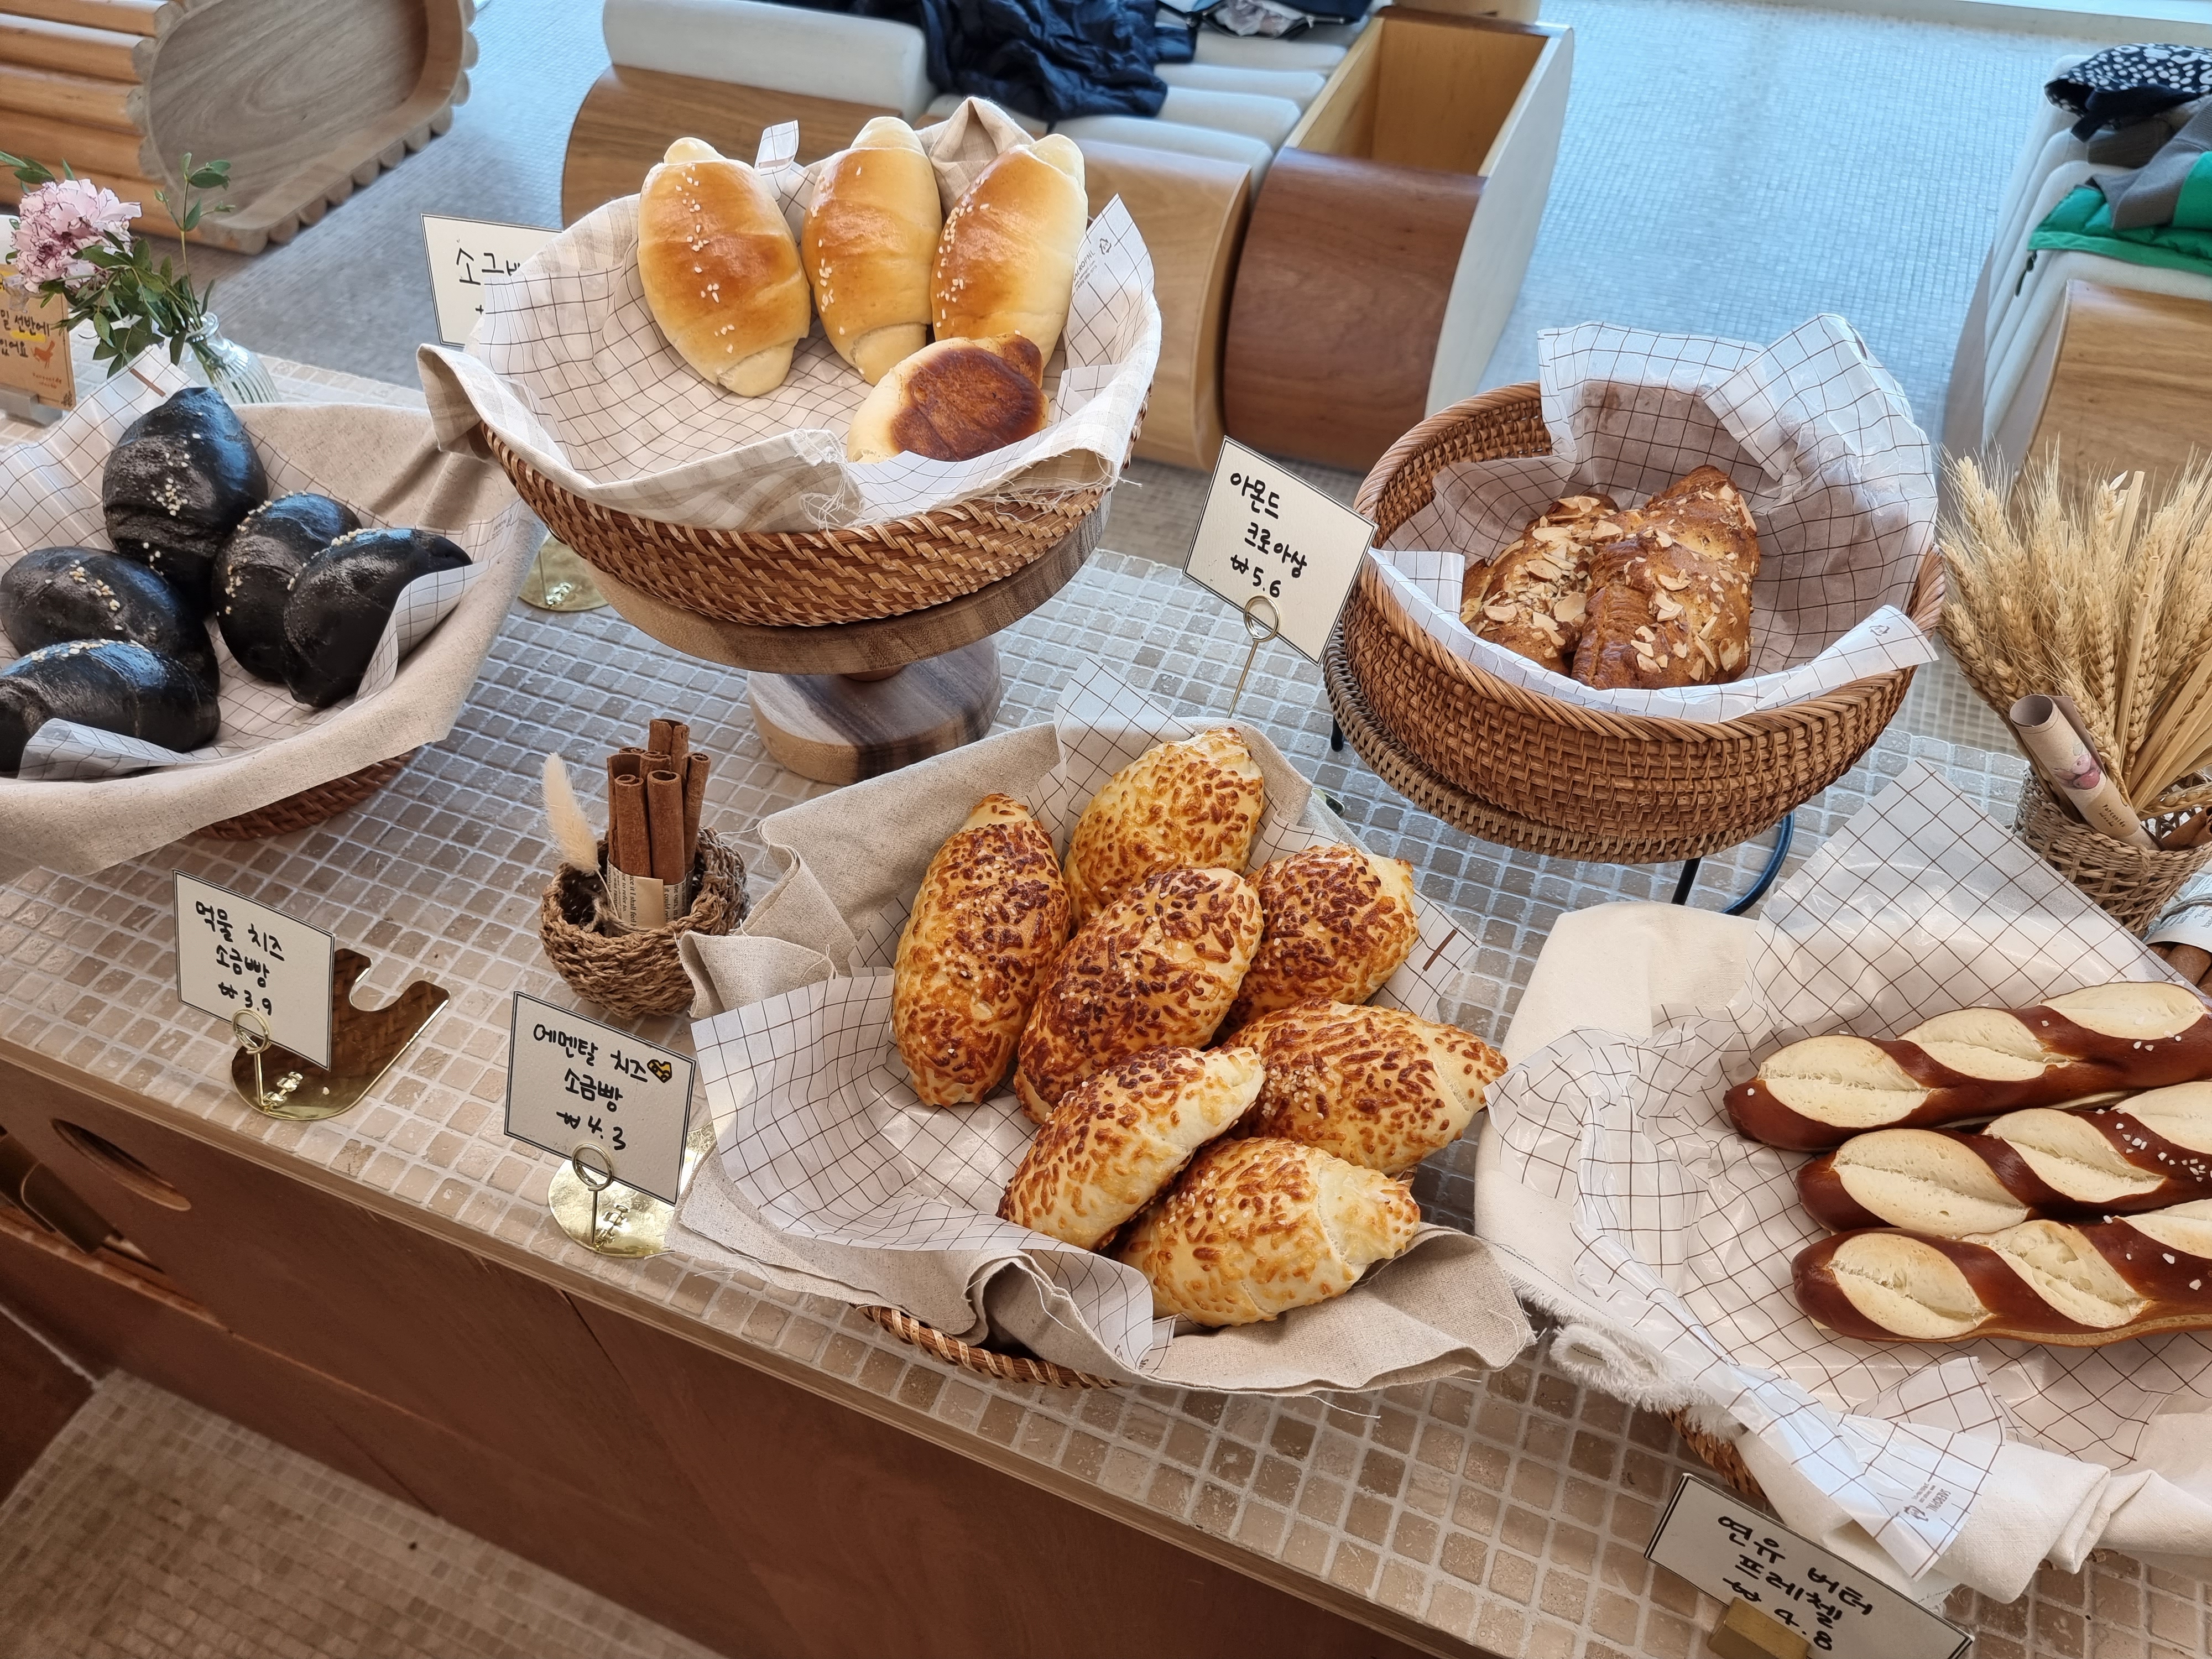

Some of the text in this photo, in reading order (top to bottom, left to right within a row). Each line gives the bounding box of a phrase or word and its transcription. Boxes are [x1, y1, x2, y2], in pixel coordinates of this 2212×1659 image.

[15, 315, 50, 337] 선반에
[1230, 472, 1280, 520] 아몬드
[1244, 522, 1307, 578] 크로아상
[196, 901, 285, 962] 먹물 치즈
[216, 945, 270, 988] 소금빵
[533, 1024, 648, 1082] 에멘탈 치즈
[565, 1068, 623, 1112] 소금빵
[1718, 1516, 1873, 1616] 연유 버터
[1735, 1554, 1843, 1630] 프레첼
